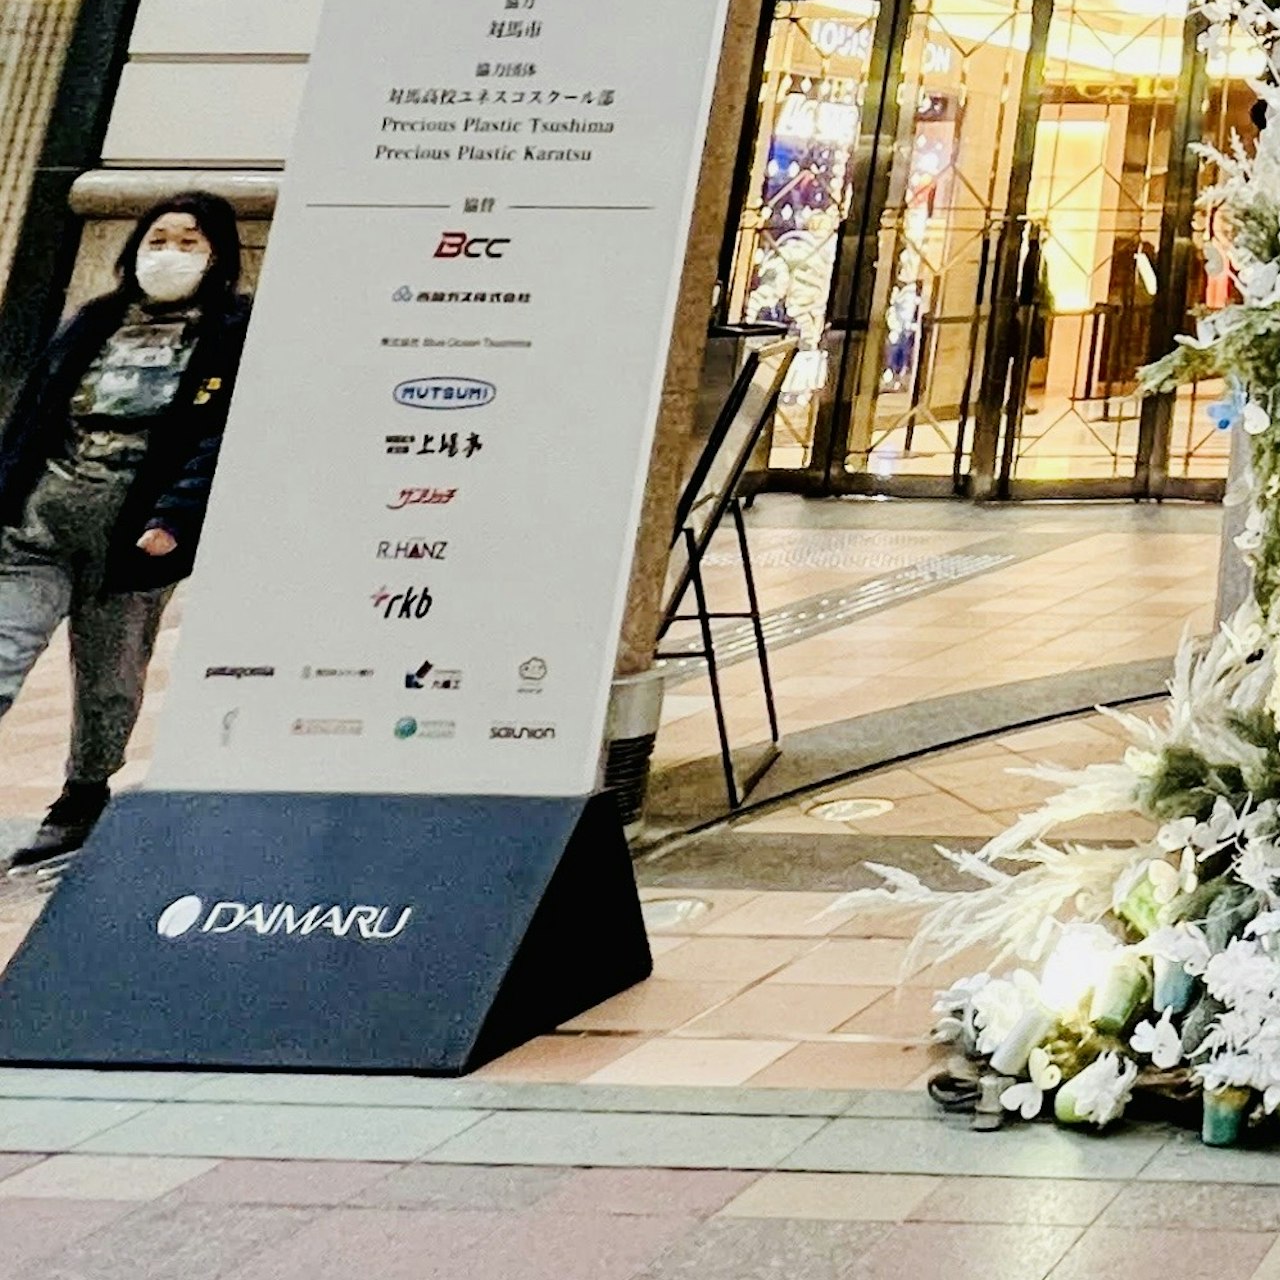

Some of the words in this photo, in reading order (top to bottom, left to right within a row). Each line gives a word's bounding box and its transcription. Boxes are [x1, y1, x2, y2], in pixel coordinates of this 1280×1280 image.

[487, 20, 544, 38] 対馬市
[380, 116, 457, 133] Precious
[462, 116, 523, 134] Plastic
[528, 117, 615, 134] Tsushima
[374, 144, 451, 161] Precious
[456, 144, 519, 162] Plastic
[523, 144, 593, 162] Karatsu
[401, 386, 488, 400] MUTSUMI
[383, 585, 433, 619] rkb
[199, 900, 413, 939] DAIMARU
